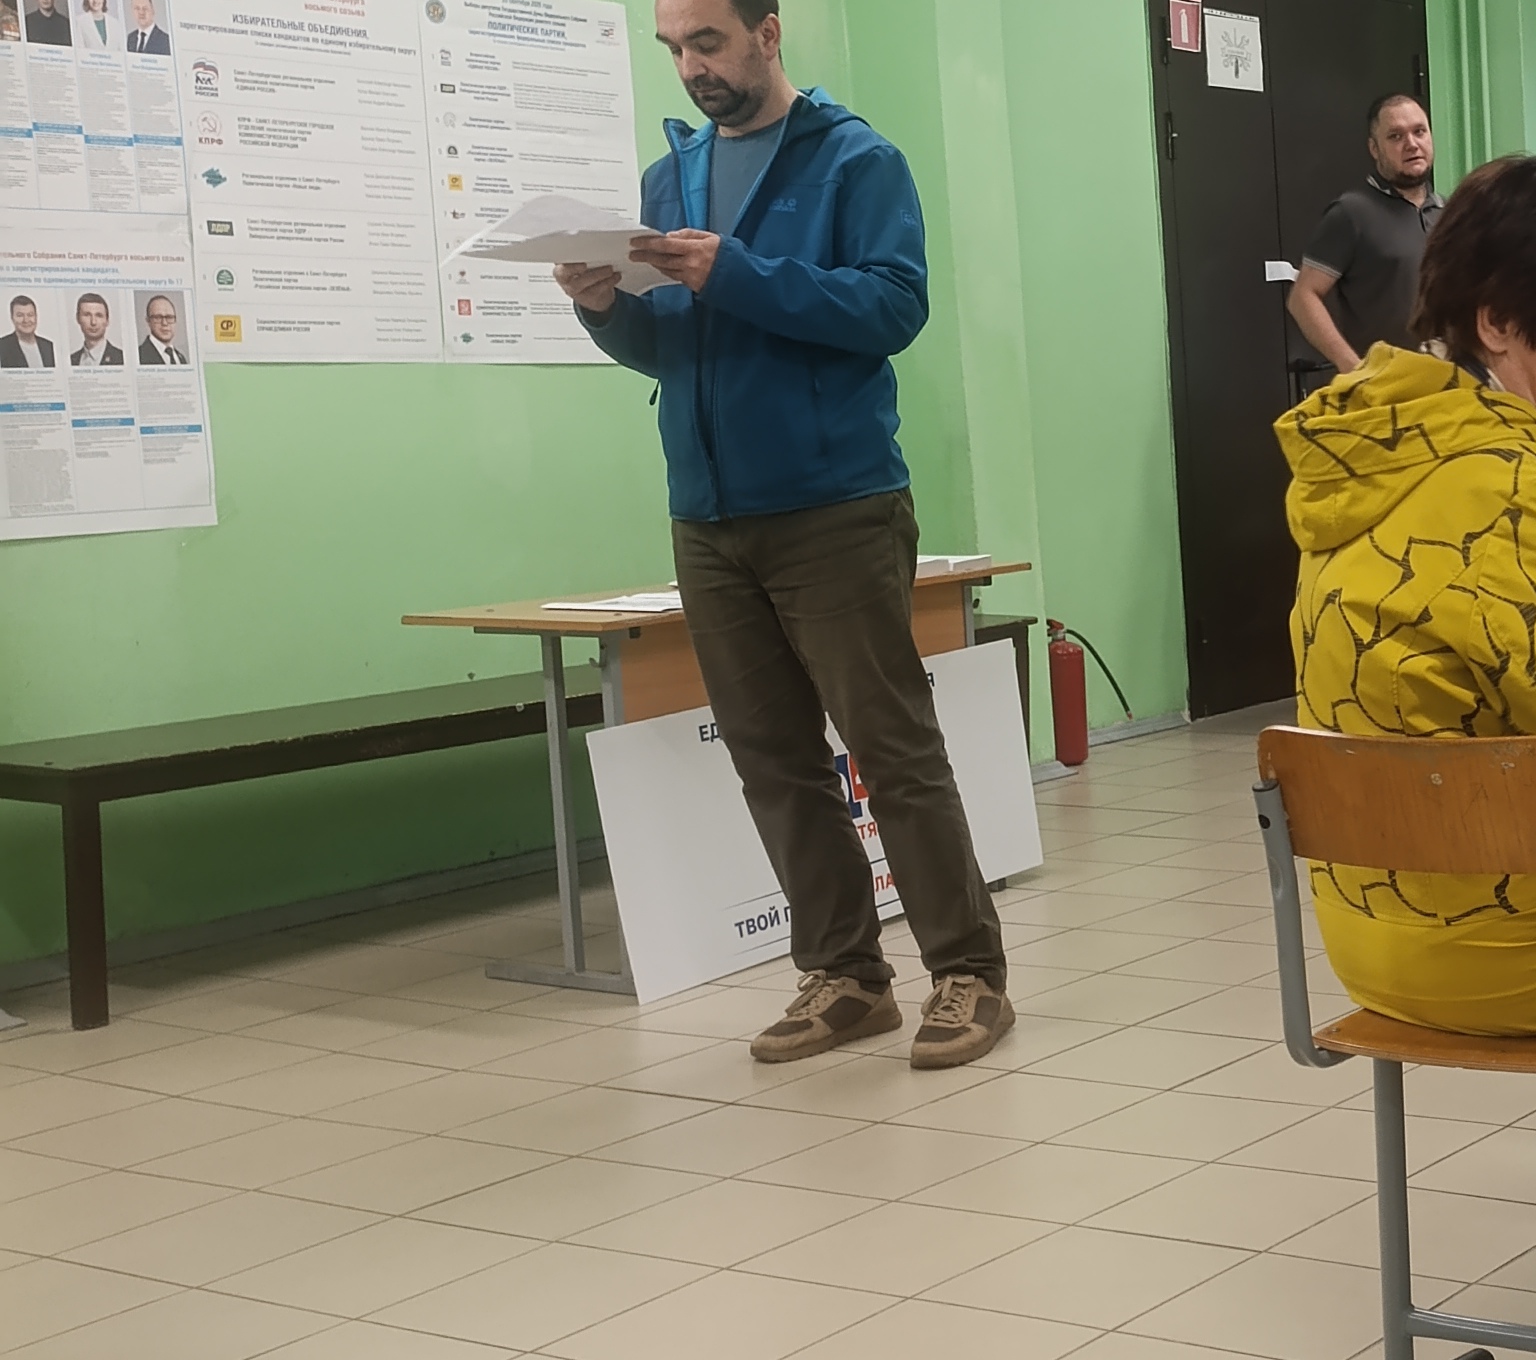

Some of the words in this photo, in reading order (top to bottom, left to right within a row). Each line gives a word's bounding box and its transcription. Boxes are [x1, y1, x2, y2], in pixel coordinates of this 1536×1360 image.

[233, 14, 304, 30] ИЗБИРАТЕЛЬНЫЕ
[307, 22, 368, 39] ОБЪЕДИНЕНИЯ,
[488, 22, 538, 35] ПОЛИТИЧЕСКИЕ
[198, 136, 223, 146] КПРФ
[734, 906, 781, 939] ТВОЙ
